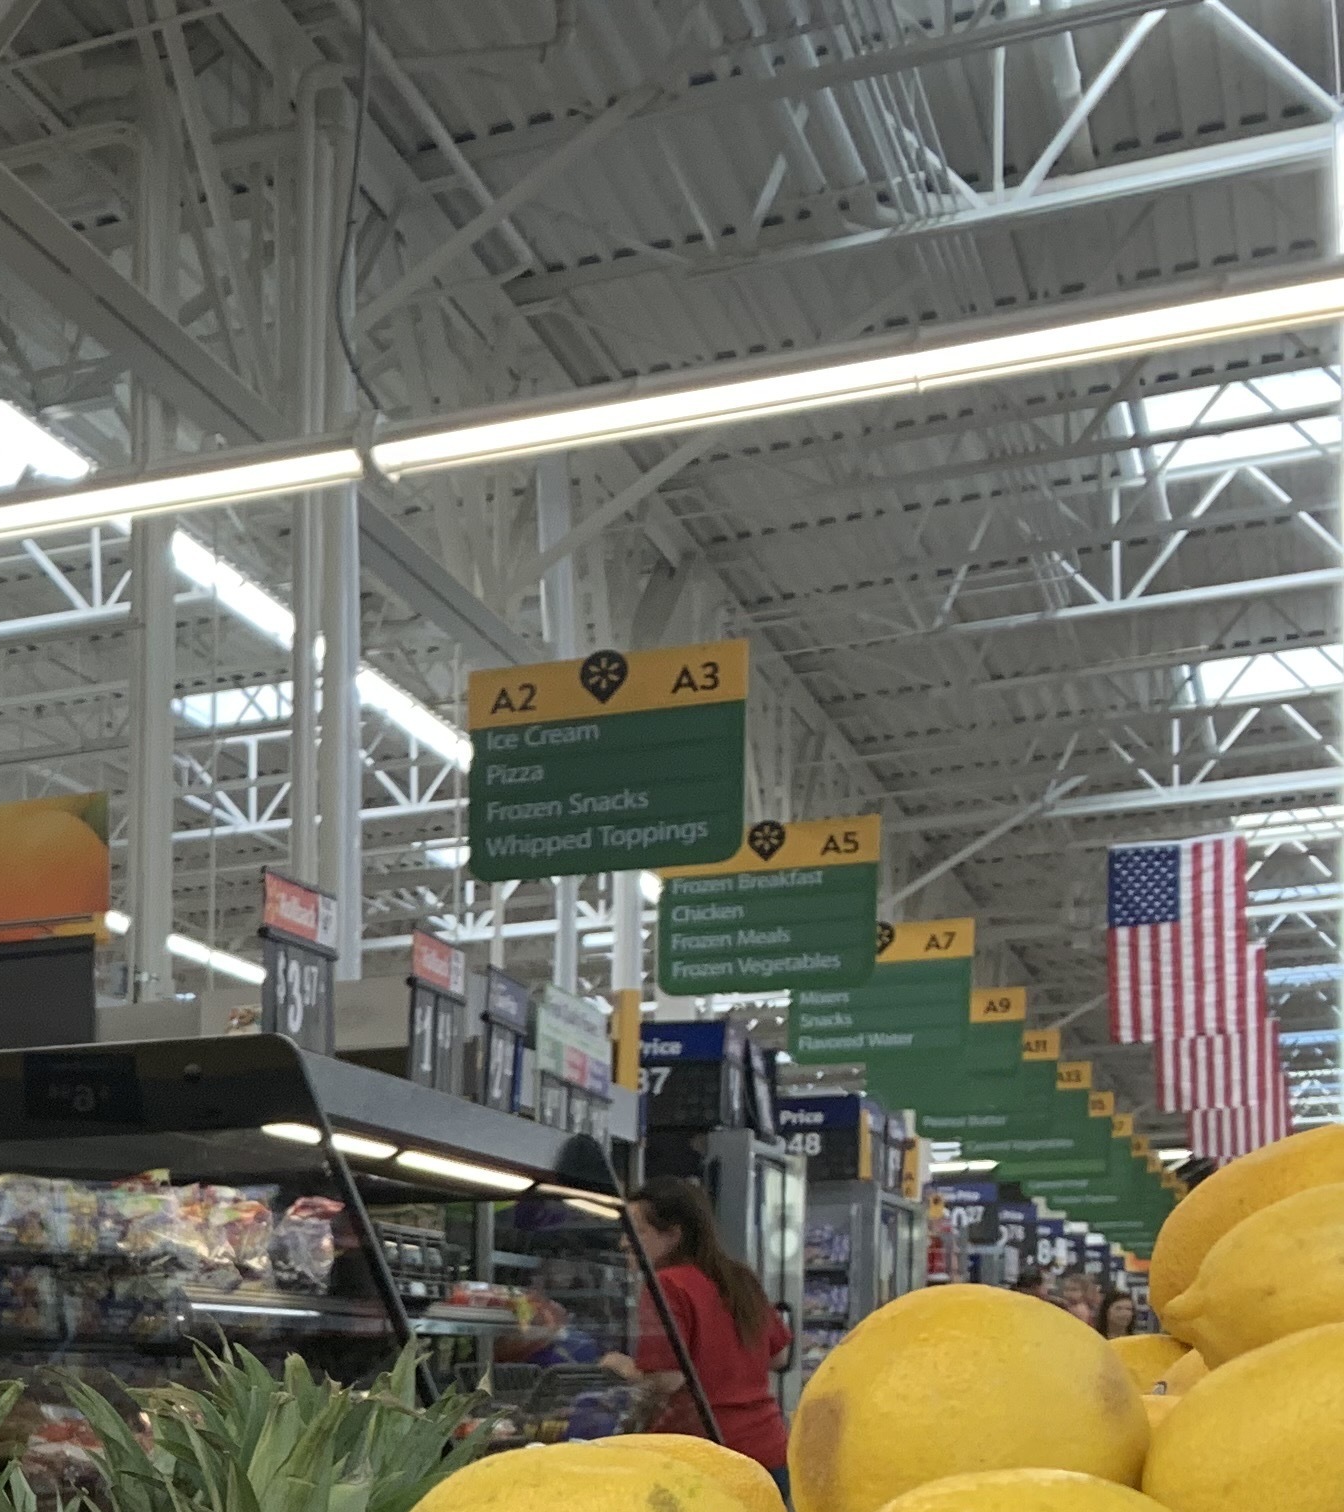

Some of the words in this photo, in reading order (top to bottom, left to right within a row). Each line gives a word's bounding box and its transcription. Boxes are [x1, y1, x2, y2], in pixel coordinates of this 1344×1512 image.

[670, 661, 721, 695] A3
[490, 682, 538, 715] A2
[487, 730, 520, 751] Ice
[524, 724, 600, 747] Cream
[486, 763, 545, 785] Pizza
[486, 800, 563, 823] Frozen
[568, 788, 650, 815] Snacks
[485, 826, 592, 858] Whipped
[598, 819, 709, 850] Toppings
[820, 831, 860, 856] A5
[672, 877, 734, 895] Frozen
[738, 869, 823, 889] Breakfast
[671, 904, 745, 922] Chicken
[671, 933, 732, 950] Frozen
[737, 926, 791, 946] Meals
[924, 931, 957, 952] A7
[672, 960, 734, 978] Frozen
[738, 951, 841, 976] Vegetables
[983, 998, 1011, 1015] A9
[641, 1037, 682, 1058] rice
[779, 1108, 825, 1126] Price
